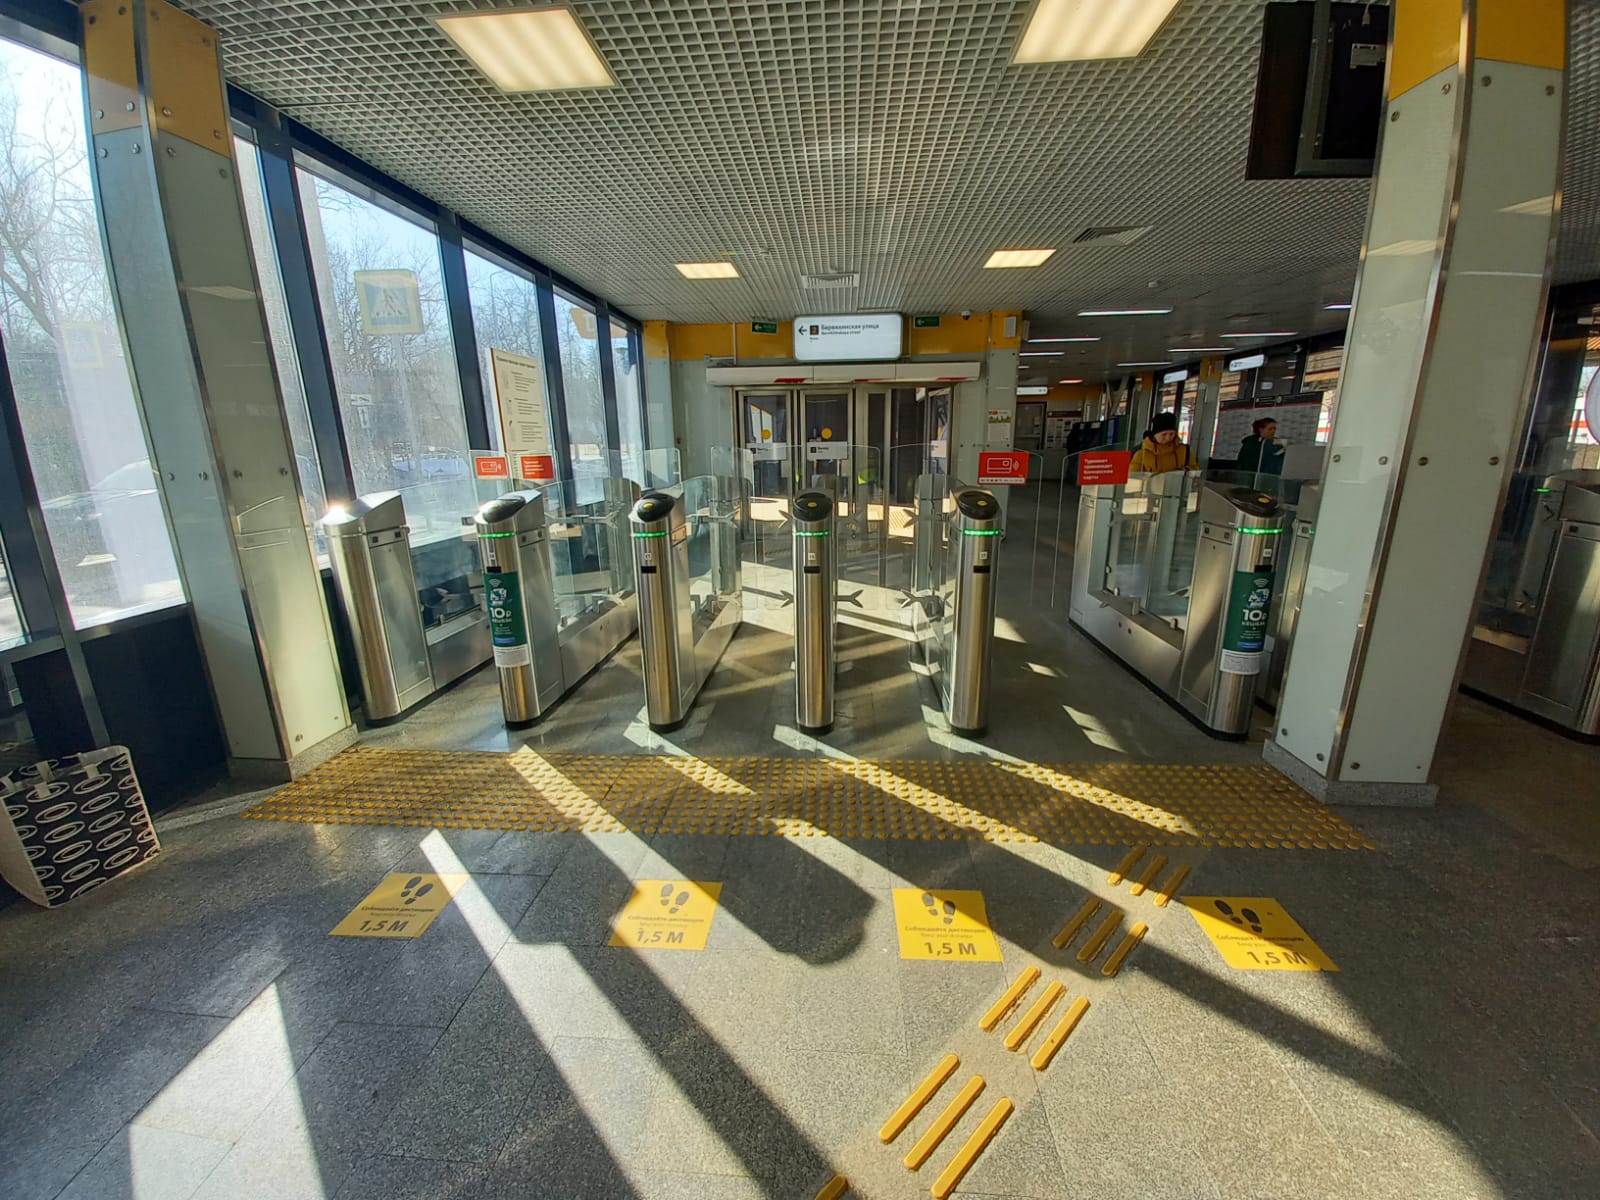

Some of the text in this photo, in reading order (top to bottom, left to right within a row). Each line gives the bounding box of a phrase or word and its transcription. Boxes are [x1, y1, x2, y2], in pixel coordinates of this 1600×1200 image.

[360, 920, 388, 933] 1,5
[636, 929, 662, 944] 1,5
[924, 941, 953, 956] 1,5
[1247, 951, 1280, 965] 1,5
